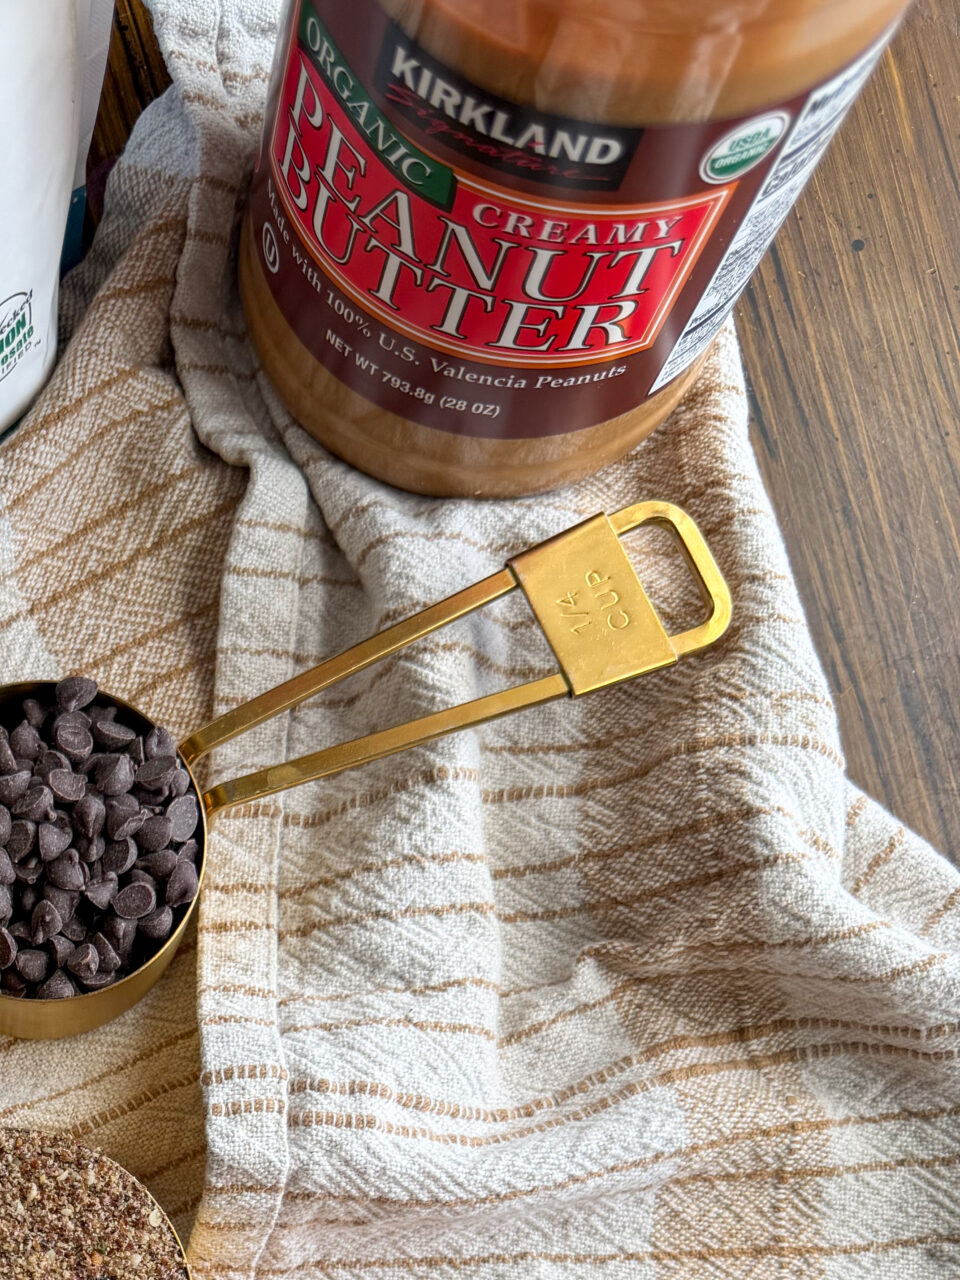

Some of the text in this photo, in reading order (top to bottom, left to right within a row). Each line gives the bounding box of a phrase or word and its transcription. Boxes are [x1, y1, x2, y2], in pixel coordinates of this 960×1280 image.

[306, 17, 432, 186] ORGANIC
[391, 45, 622, 164] KIRKLAND
[729, 127, 771, 152] USDA
[289, 54, 685, 302] PEANUT
[472, 203, 683, 245] CREAMY
[279, 113, 639, 351] BUTTER
[268, 180, 627, 389] Made with 100% U.S. Valencia Peanuts
[326, 329, 501, 419] NET WT 793.8g (28 OZ)
[556, 591, 591, 635] 1/4
[584, 570, 629, 631] CUP
